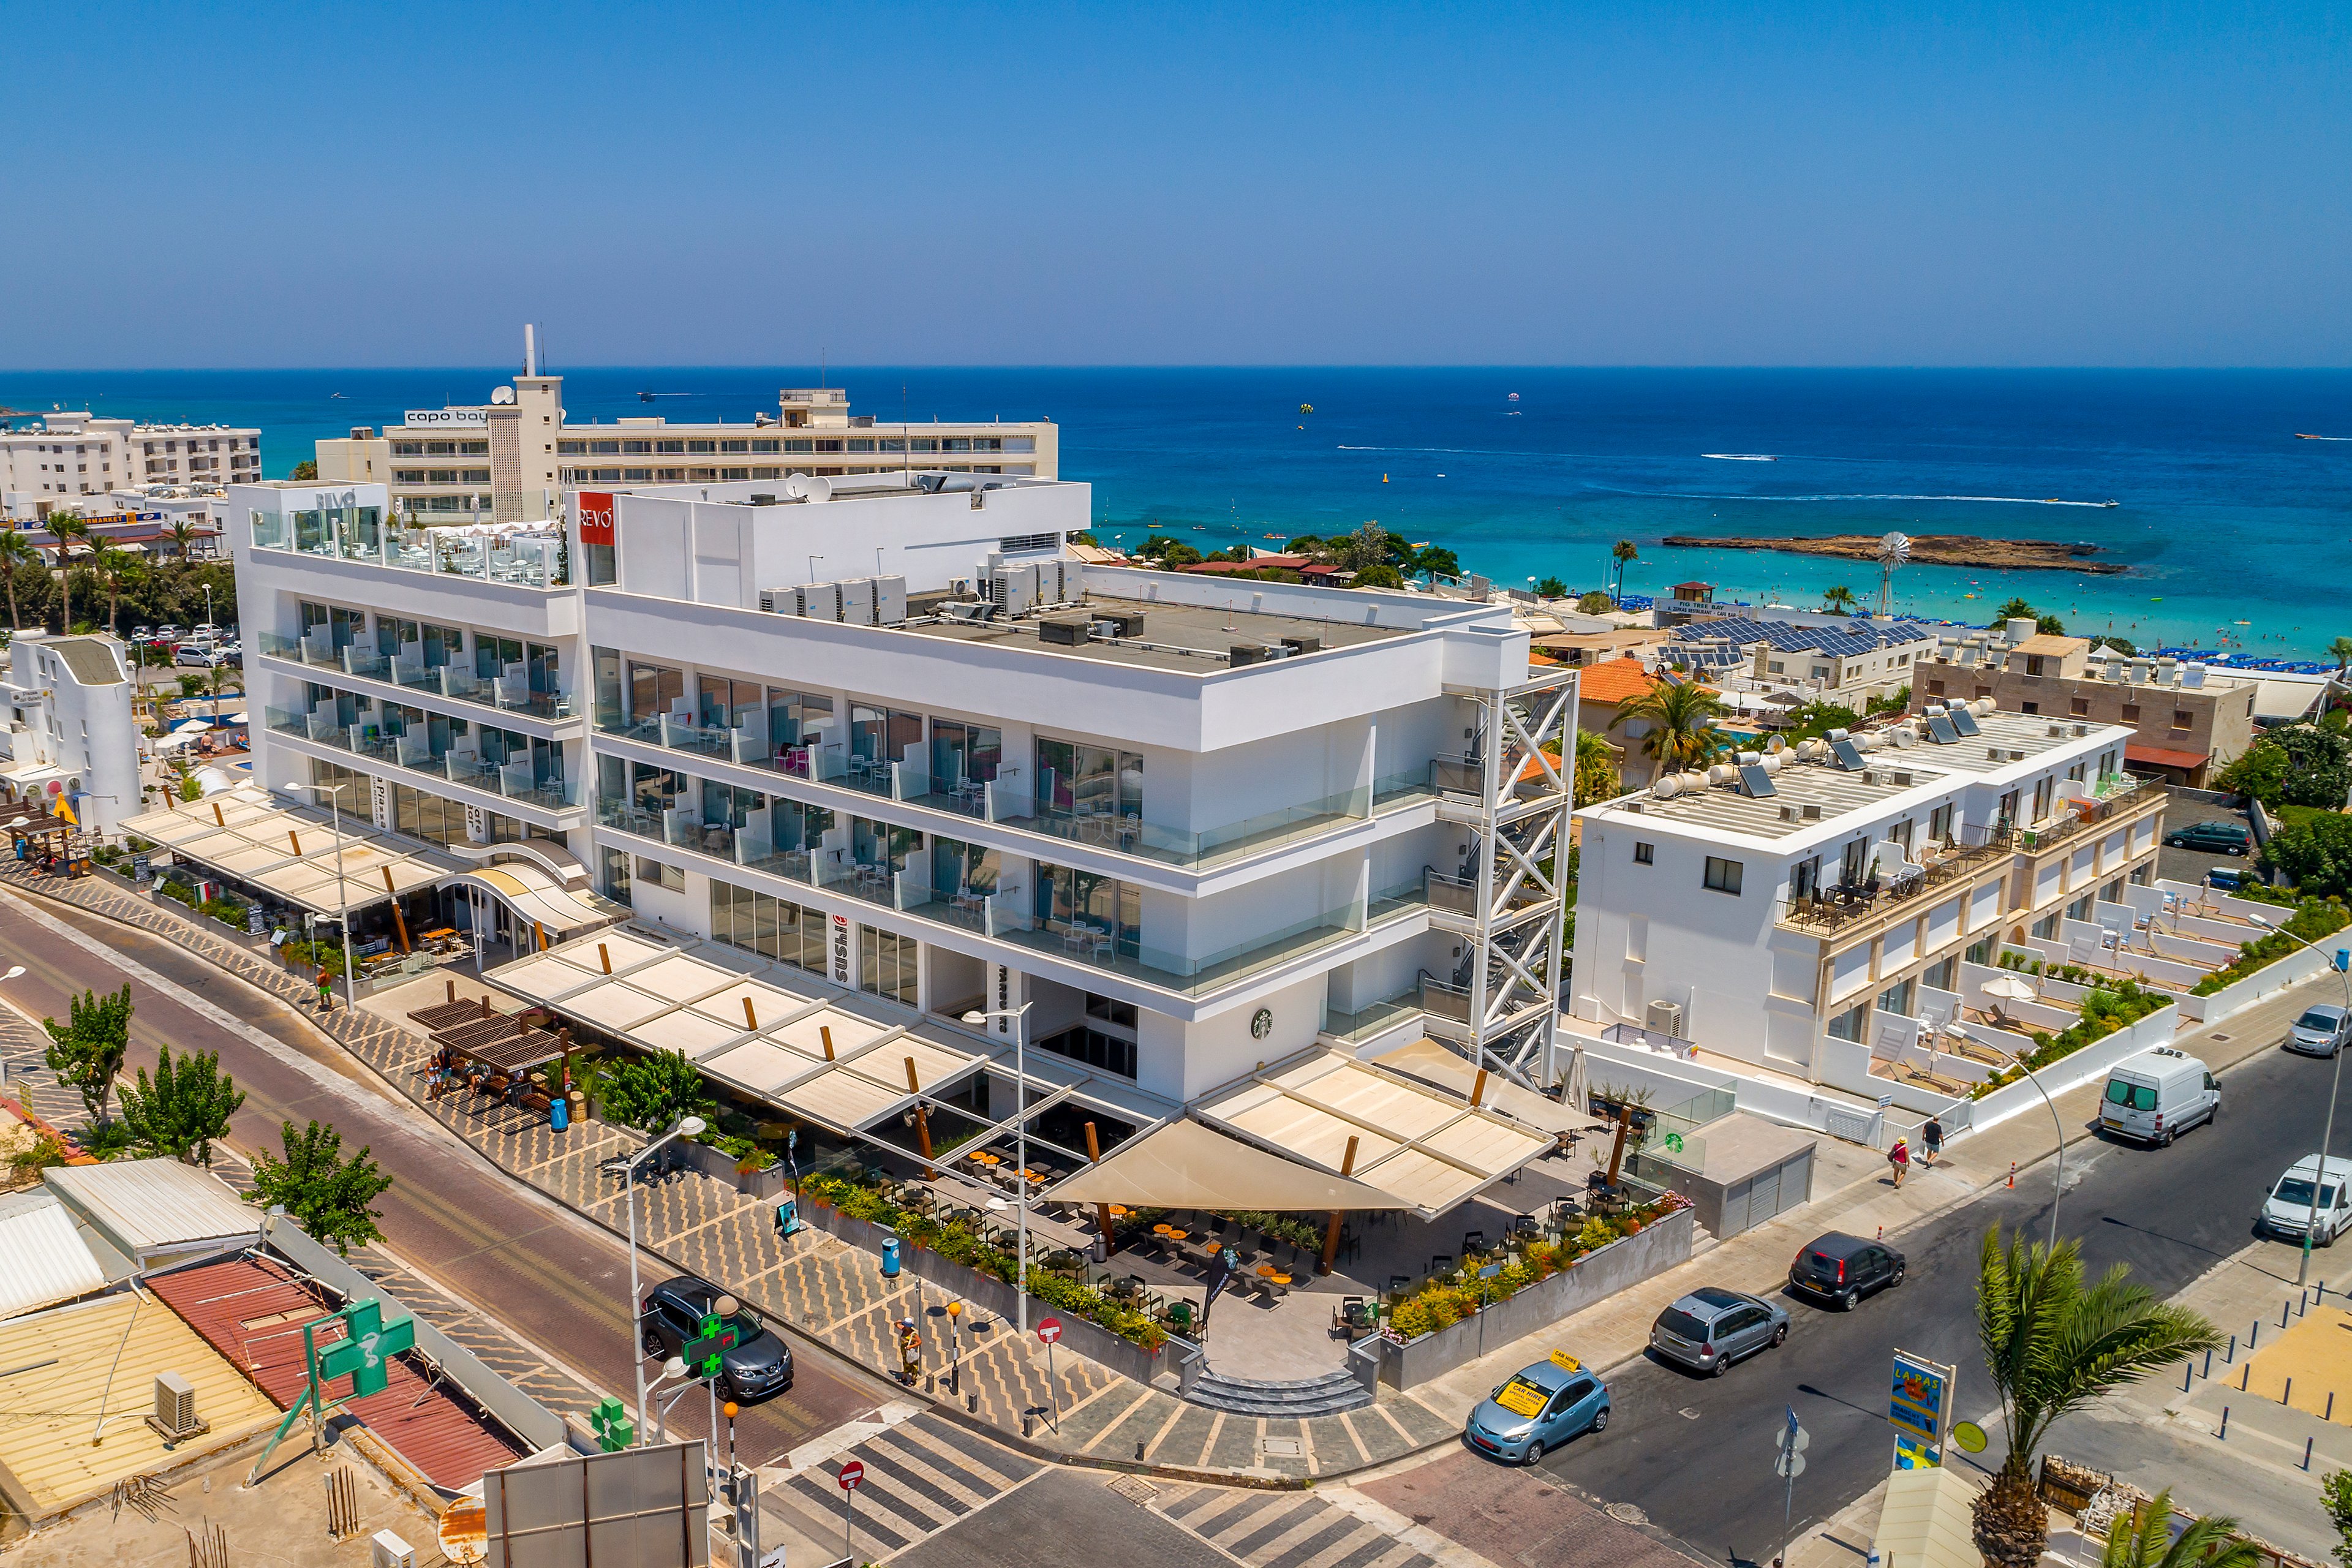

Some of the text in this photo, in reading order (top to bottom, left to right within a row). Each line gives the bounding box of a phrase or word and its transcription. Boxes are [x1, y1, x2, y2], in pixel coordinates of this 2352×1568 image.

[407, 411, 488, 423] capo bay
[81, 516, 122, 524] ERMARKET
[377, 786, 386, 829] Piazza
[473, 805, 483, 833] afé
[835, 925, 848, 982] sushi
[1565, 1355, 1577, 1365] HIRE
[1894, 1368, 1939, 1389] LA PAS
[1509, 1390, 1525, 1399] SPECIAL
[1525, 1397, 1539, 1406] OFFER
[1513, 1385, 1526, 1393] CAR
[1526, 1391, 1543, 1401] HIRE
